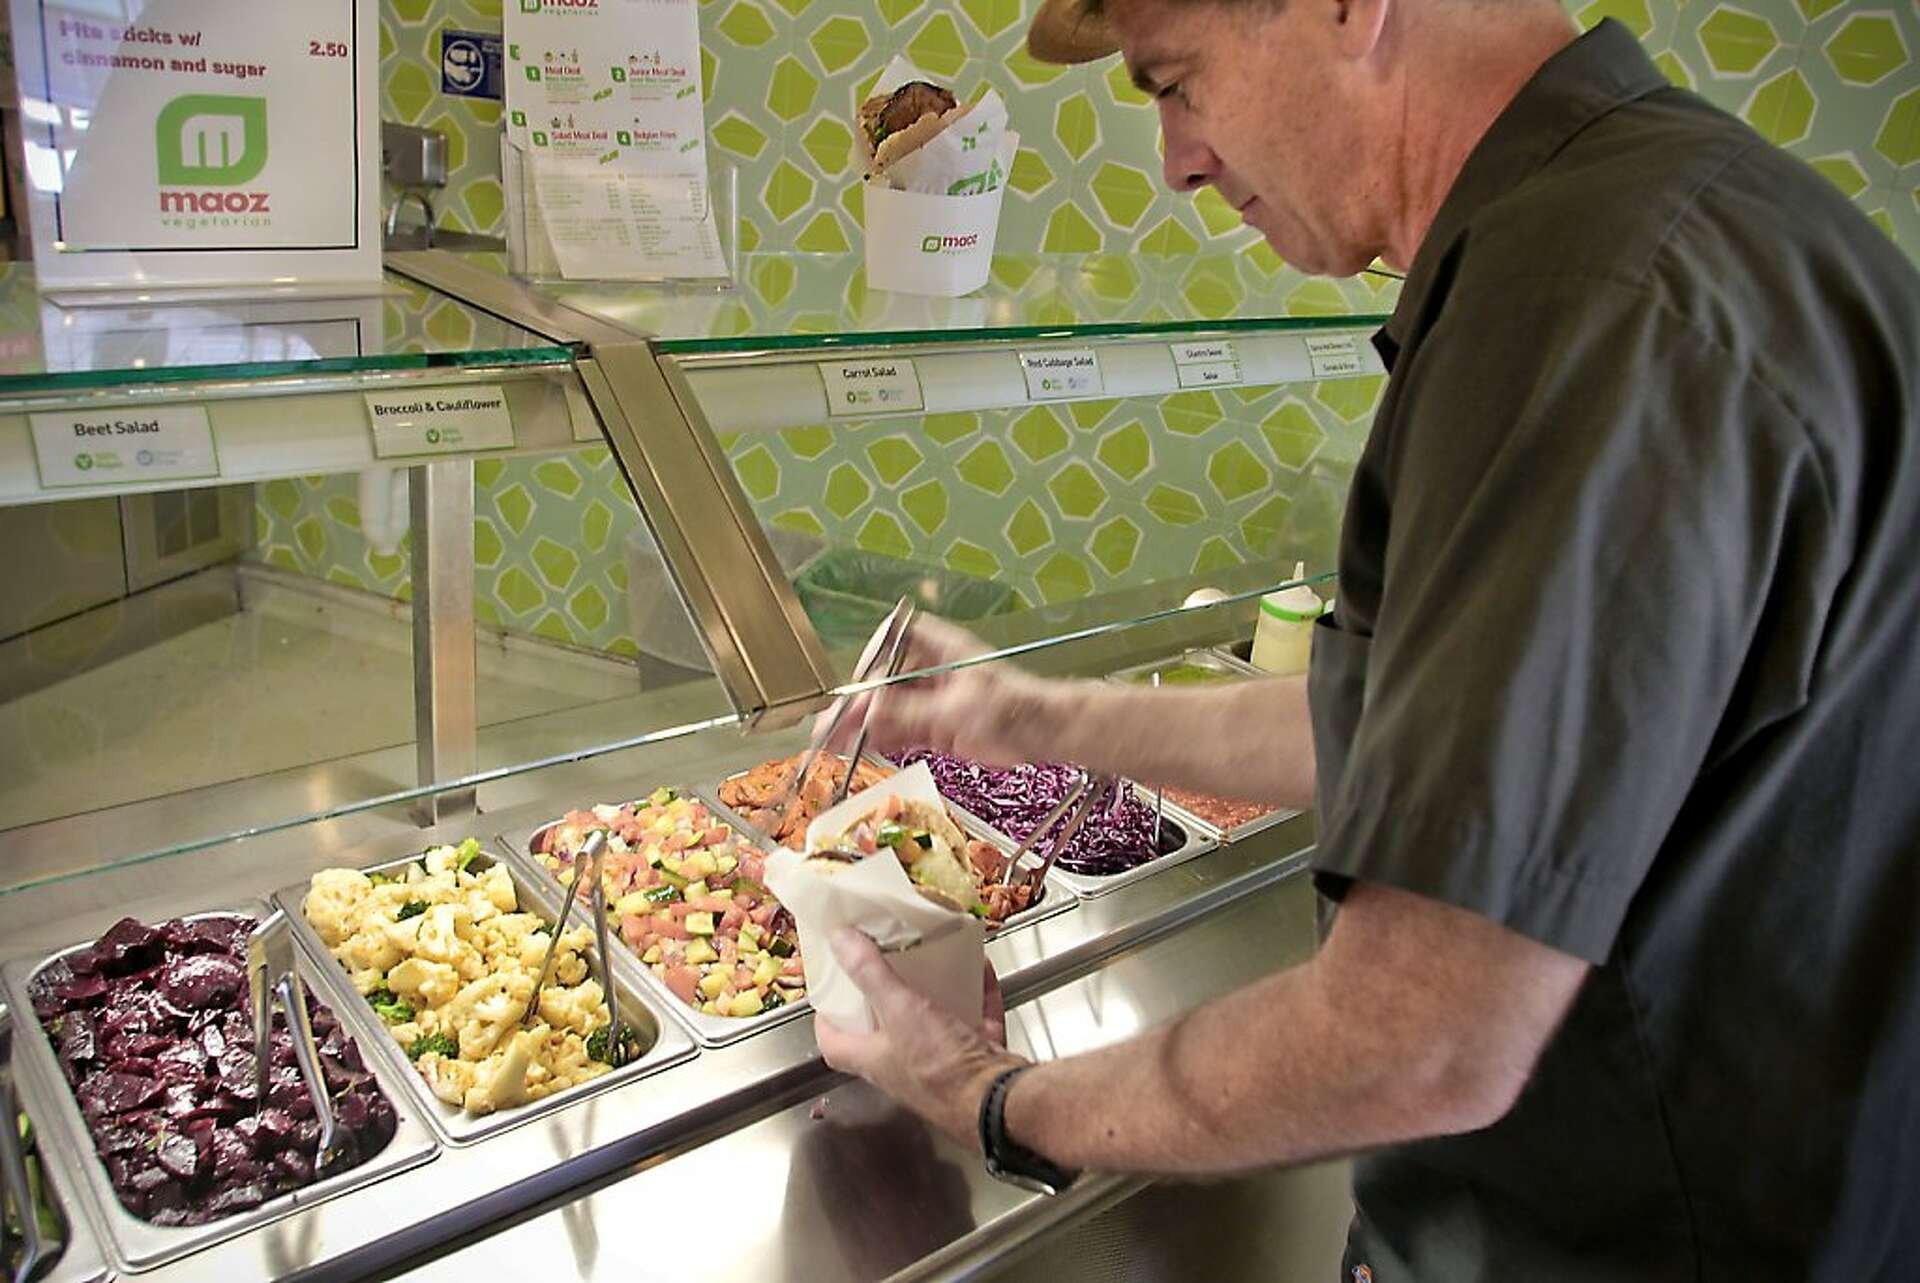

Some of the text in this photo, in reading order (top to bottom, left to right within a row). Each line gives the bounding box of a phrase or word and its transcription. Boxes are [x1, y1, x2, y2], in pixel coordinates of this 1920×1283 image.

[178, 32, 201, 46] w/
[309, 41, 348, 57] 2.50
[62, 49, 267, 79] cinnamon and sugar
[160, 192, 271, 213] maoz
[161, 215, 272, 230] vegetarian
[842, 366, 897, 378] Carrot Salad
[374, 399, 502, 416] Broccoli & Cauliflower
[74, 420, 160, 437] Beet Salad
